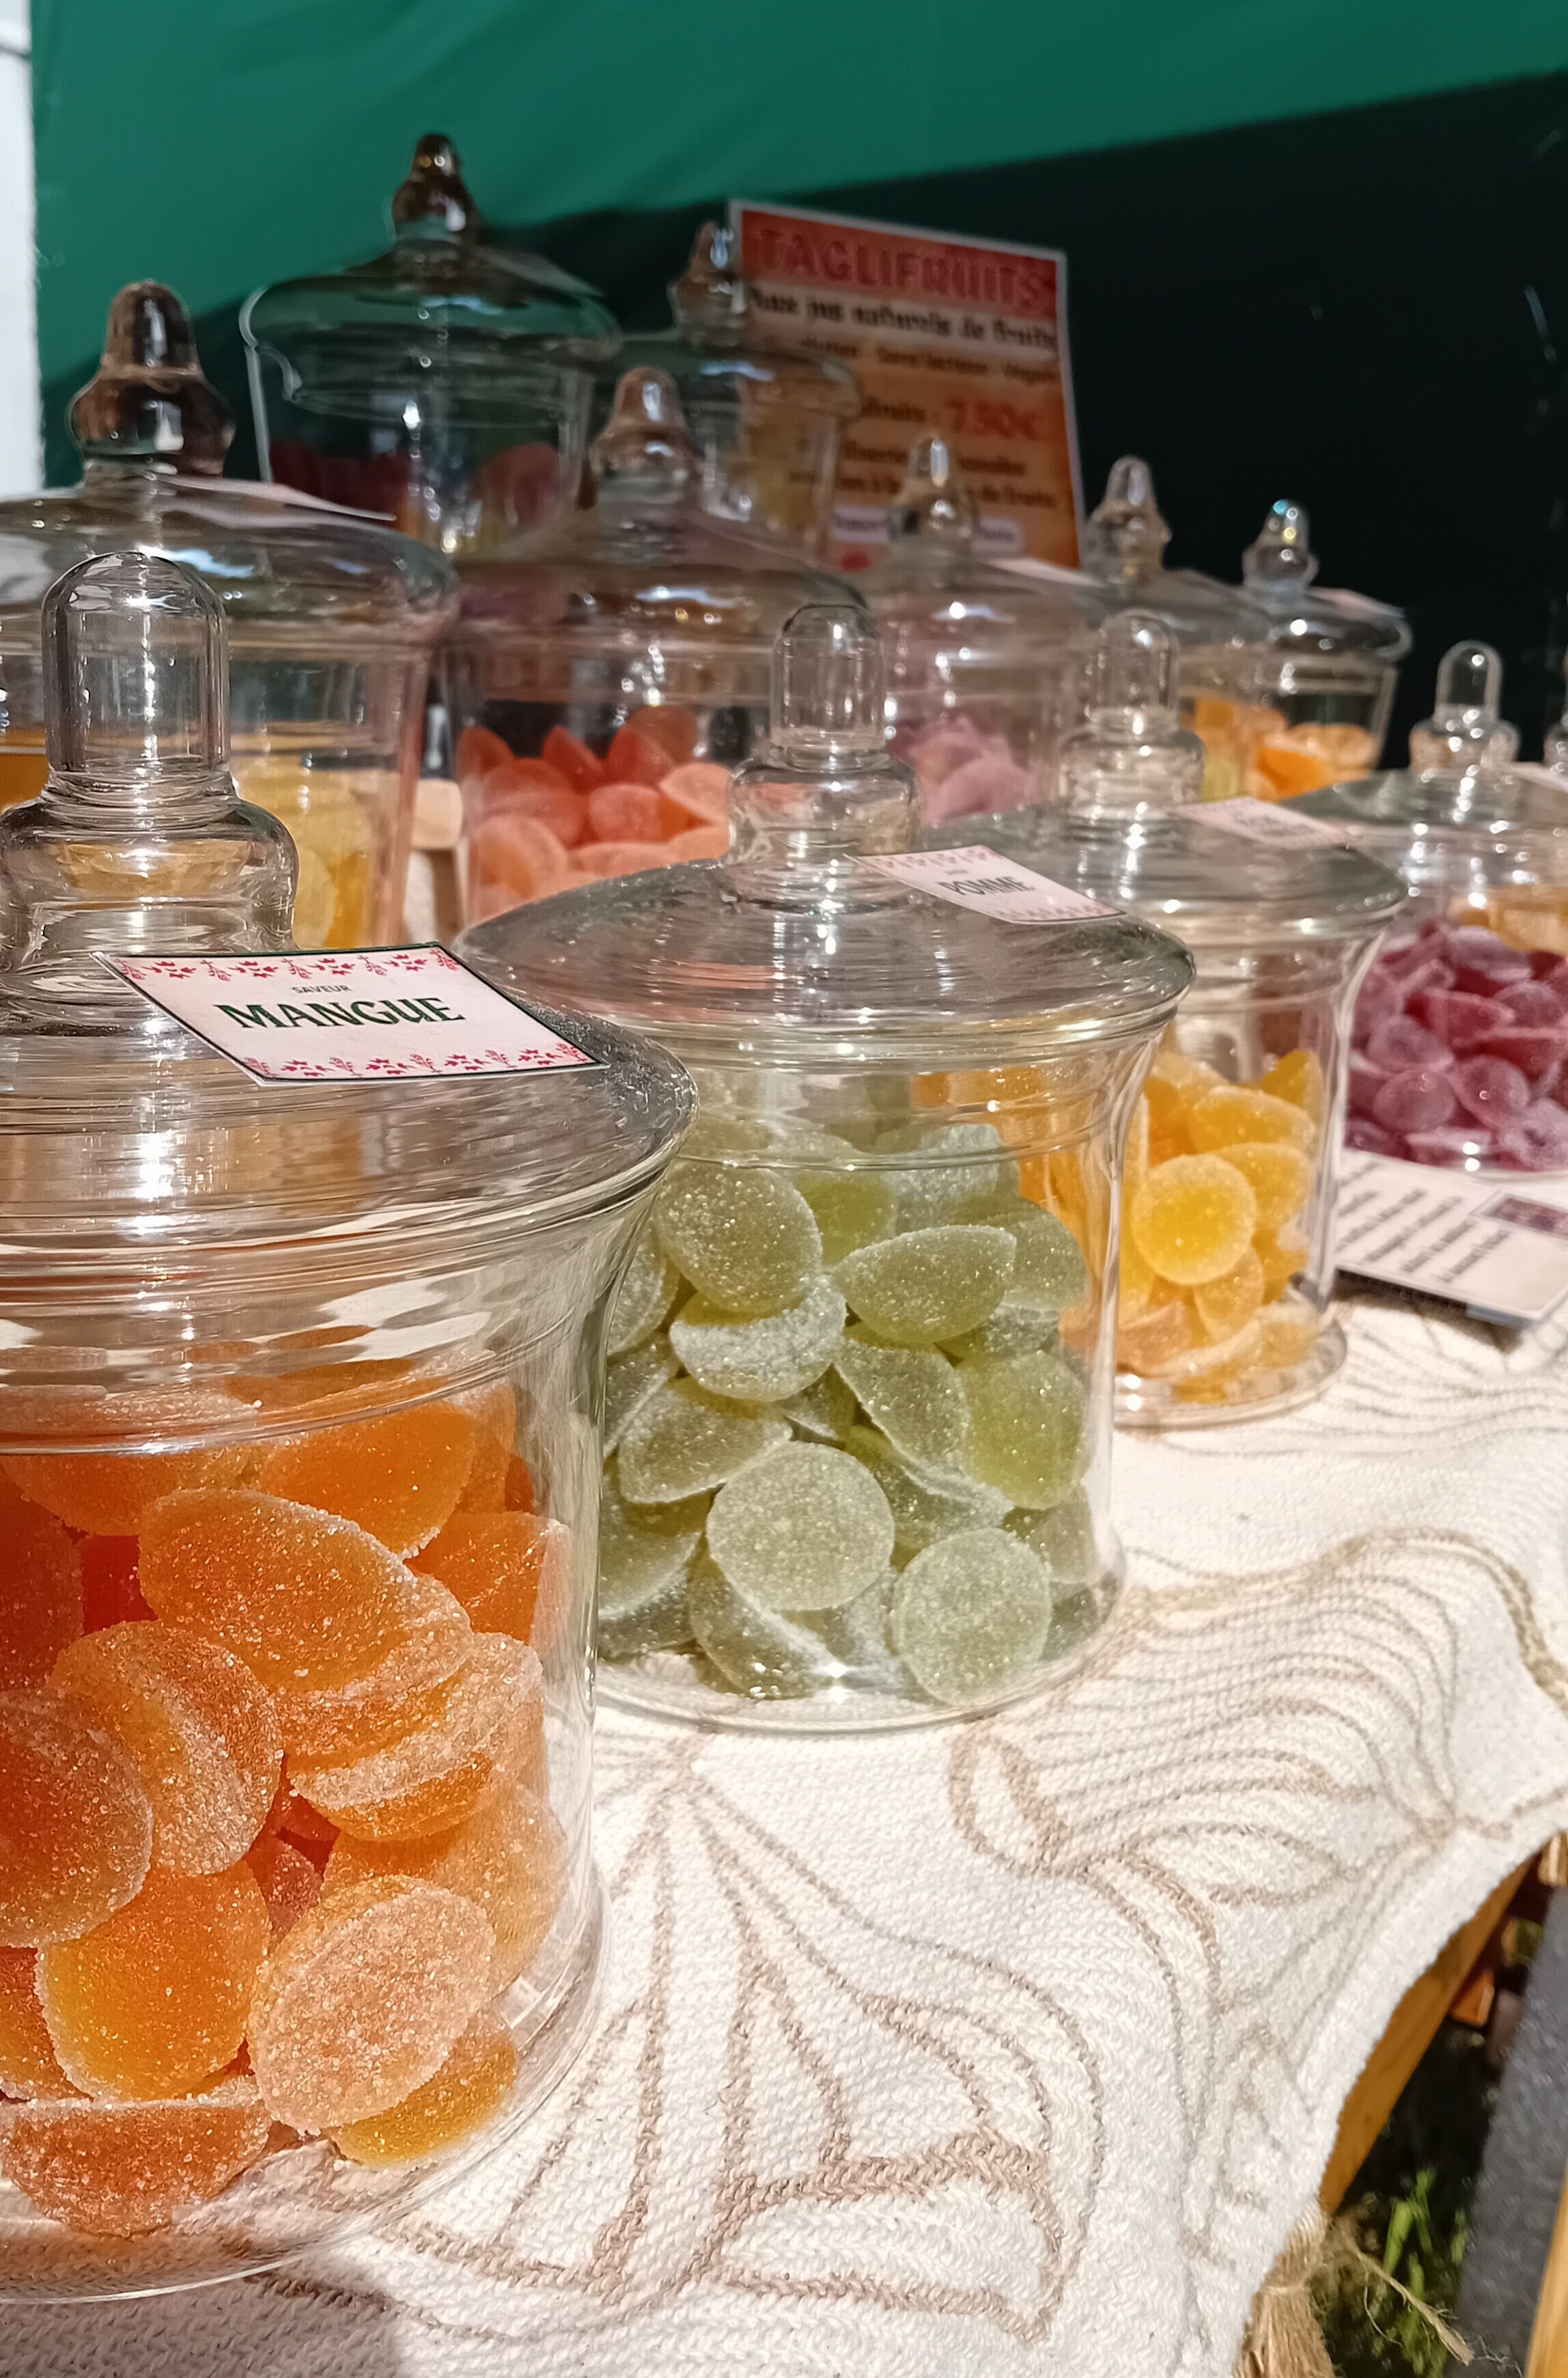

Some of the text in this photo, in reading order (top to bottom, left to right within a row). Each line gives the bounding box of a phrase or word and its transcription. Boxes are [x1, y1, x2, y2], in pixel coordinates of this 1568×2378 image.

[808, 296, 843, 324] jus
[852, 304, 951, 337] naturels
[961, 314, 984, 339] de
[992, 320, 1058, 350] fruits
[292, 984, 353, 994] SAVEUR
[212, 997, 466, 1028] MANGUE
